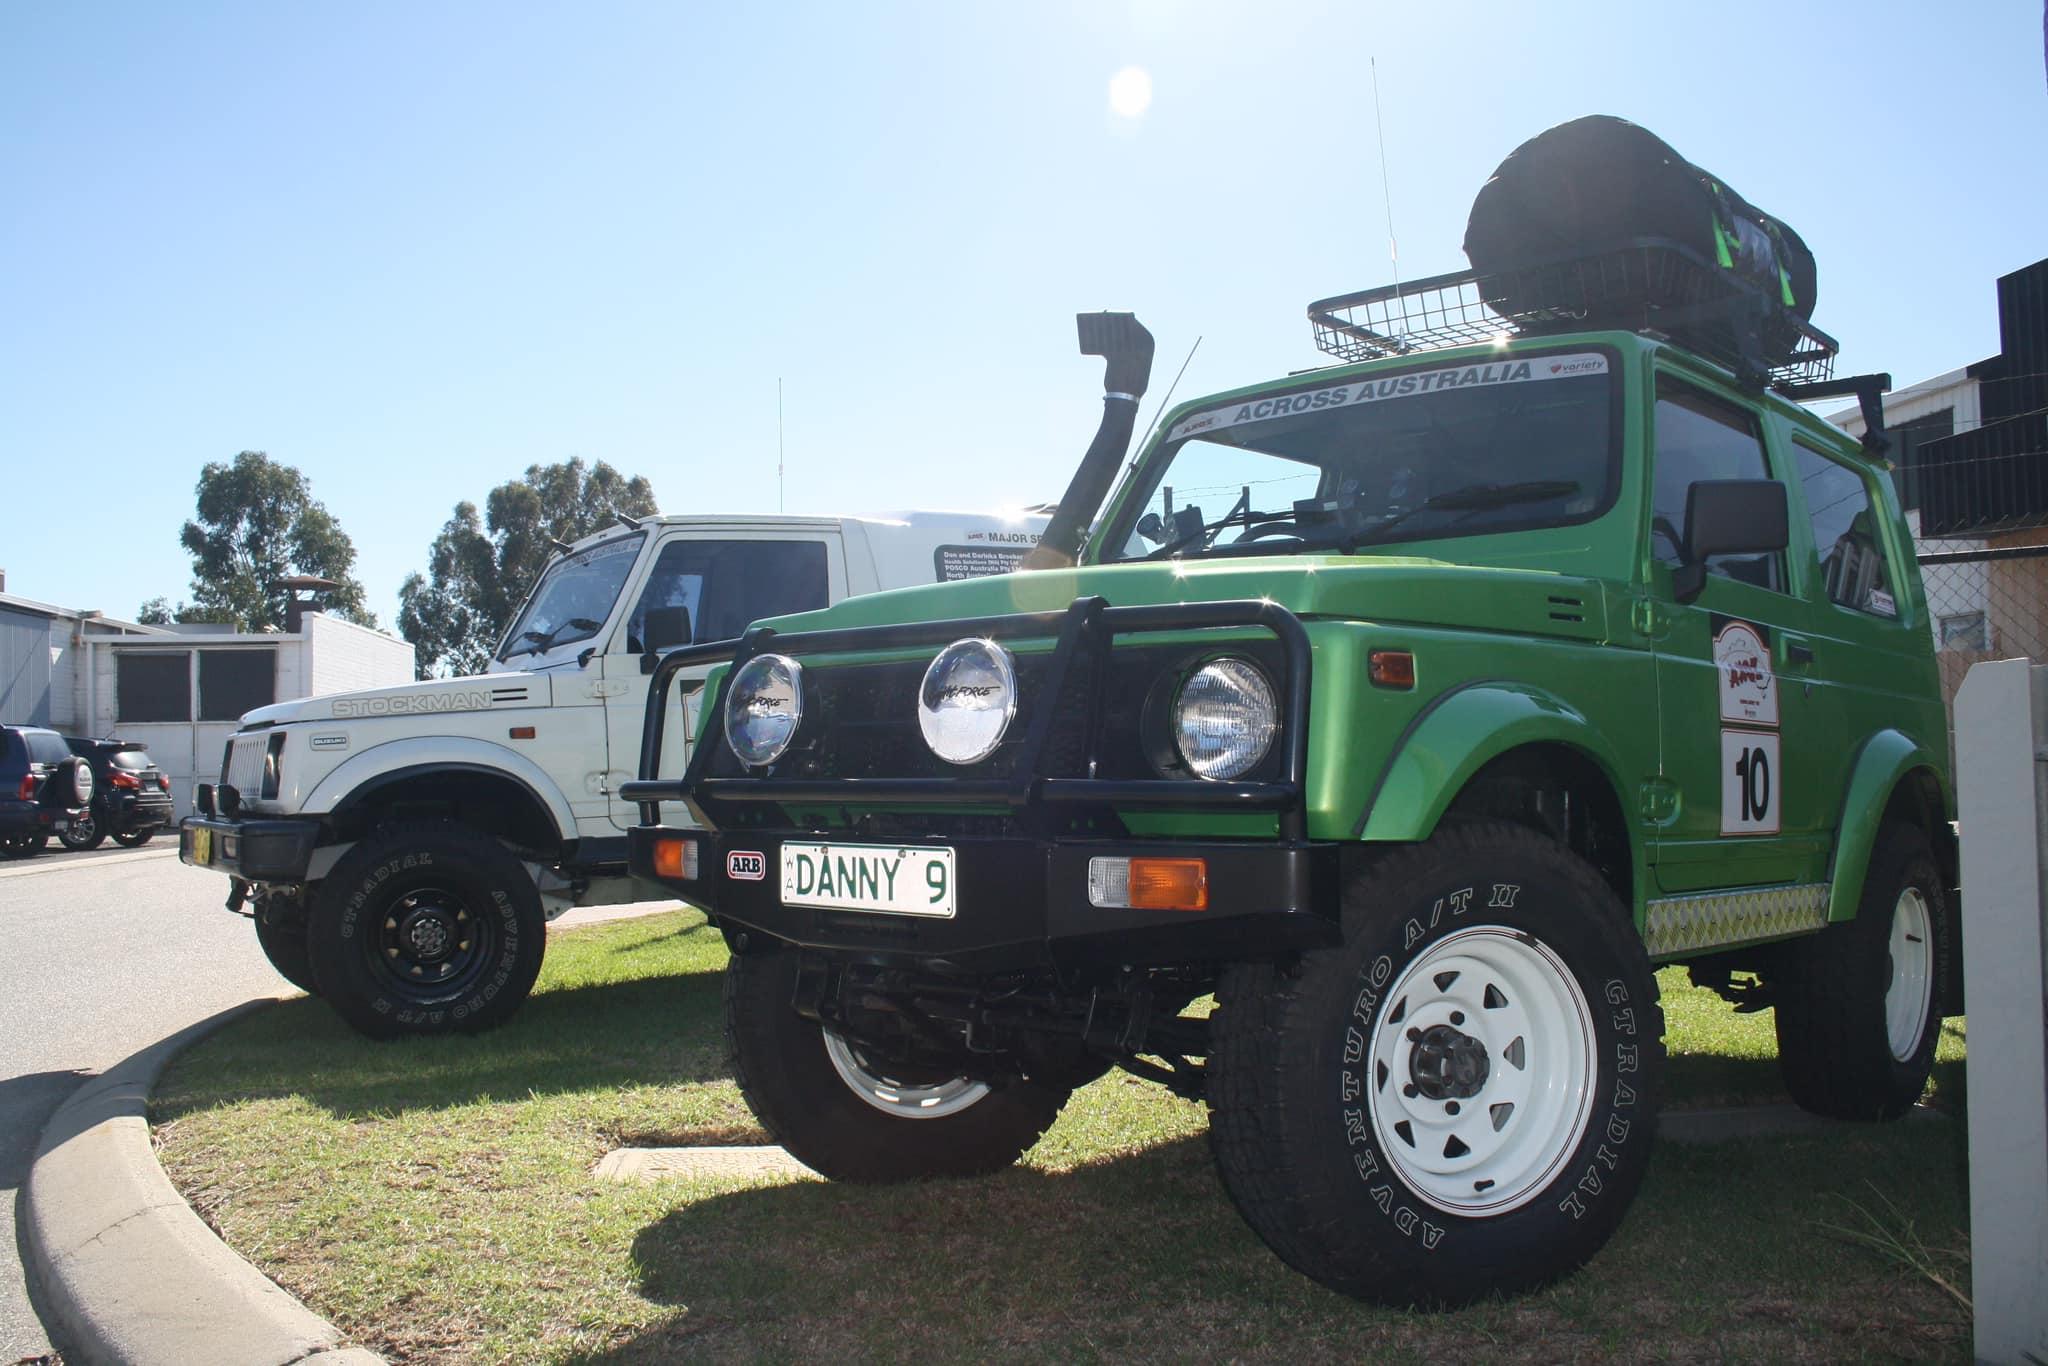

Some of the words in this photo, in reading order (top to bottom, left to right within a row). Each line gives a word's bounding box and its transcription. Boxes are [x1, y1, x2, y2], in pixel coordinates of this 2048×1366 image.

[1562, 360, 1605, 372] variety
[1233, 388, 1348, 423] ACROSS
[1355, 362, 1532, 400] AUSTRALIA
[988, 532, 1027, 543] MAJOR
[332, 692, 492, 717] STOCKMAN
[1735, 747, 1770, 822] 10
[732, 857, 761, 873] ARB
[796, 853, 901, 901] DANNY
[925, 860, 947, 904] 9
[1342, 954, 1447, 1250] ADVENTURO
[1403, 887, 1474, 949] A/T
[1488, 882, 1521, 909] II
